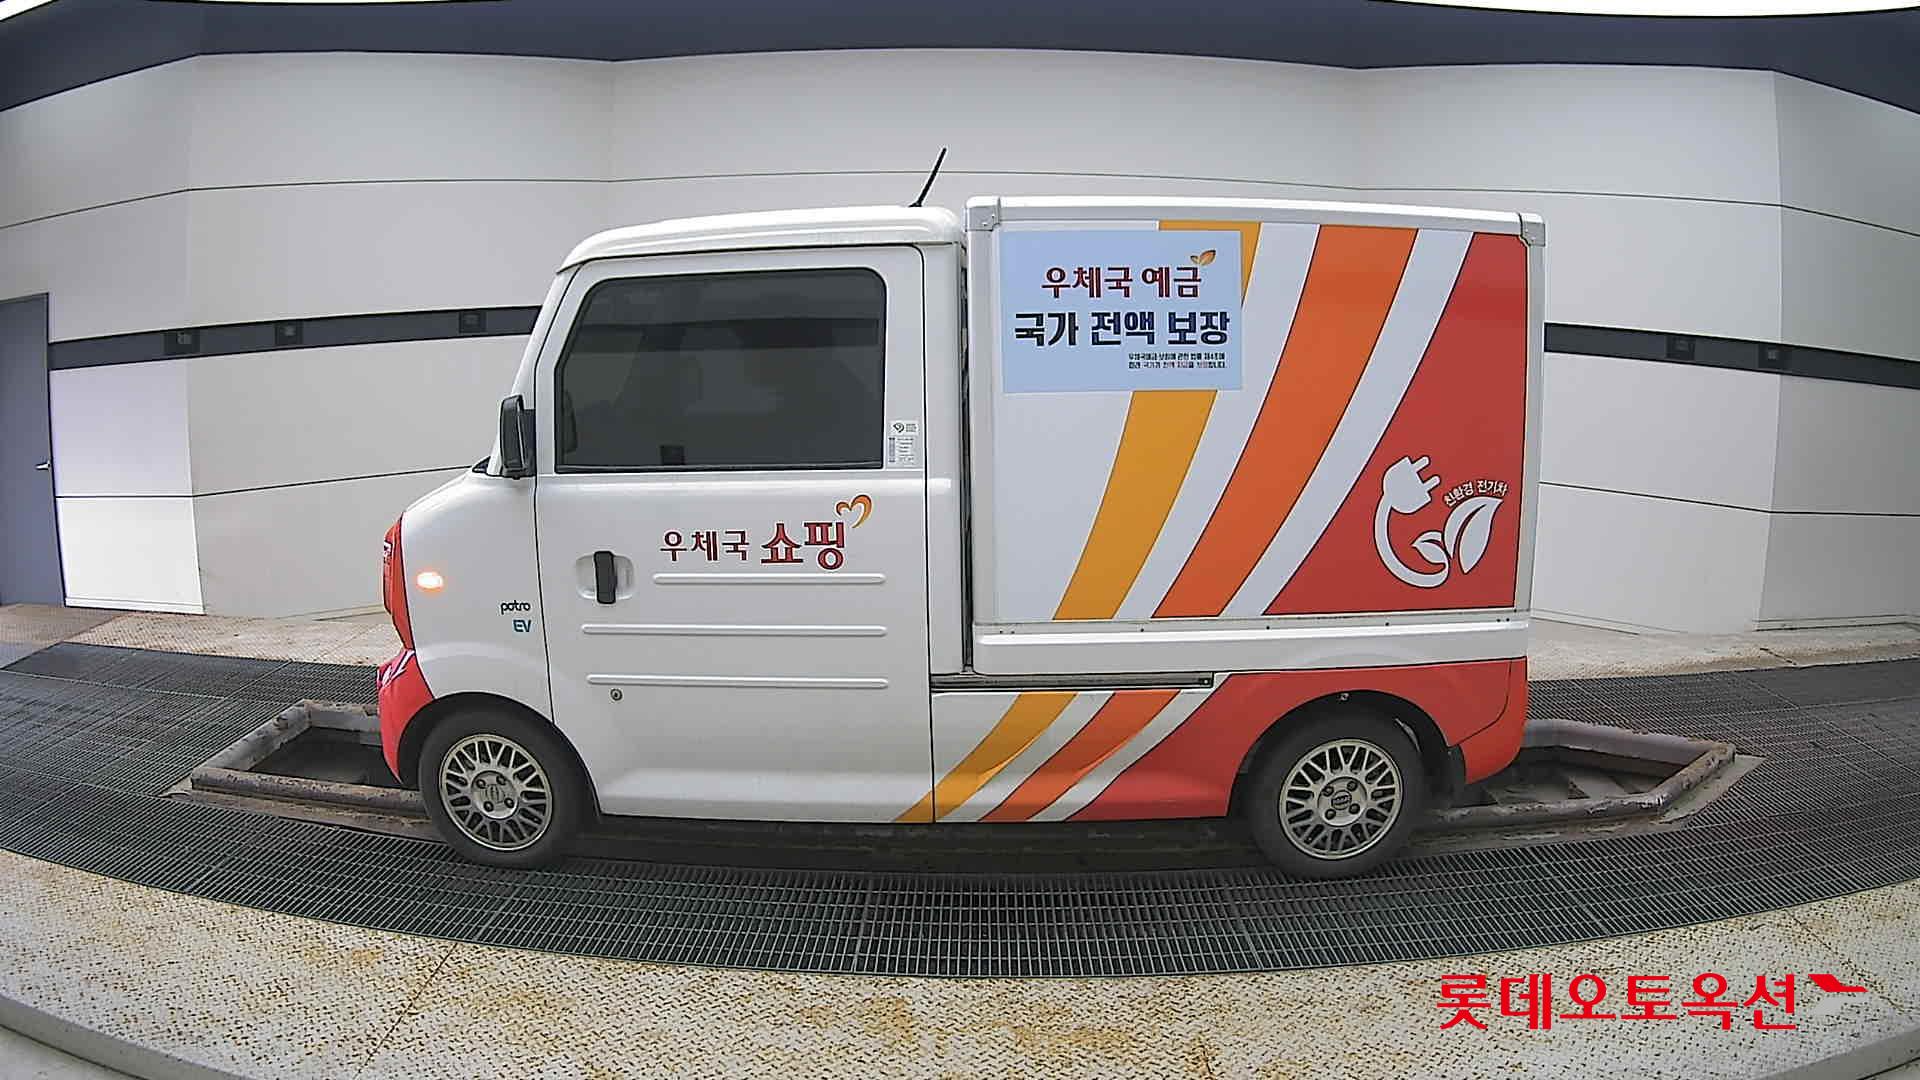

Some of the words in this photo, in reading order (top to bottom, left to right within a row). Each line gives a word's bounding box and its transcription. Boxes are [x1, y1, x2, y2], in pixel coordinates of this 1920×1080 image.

[1041, 266, 1133, 299] 우체국
[1141, 265, 1202, 298] 예금
[1014, 312, 1078, 347] 국가
[1091, 311, 1154, 346] 전액
[1168, 311, 1230, 346] 보장
[1443, 481, 1475, 507] 친환경
[1477, 479, 1508, 497] 전기차
[660, 530, 750, 562] 우체국
[760, 521, 845, 570] 쇼핑
[513, 619, 532, 633] EV
